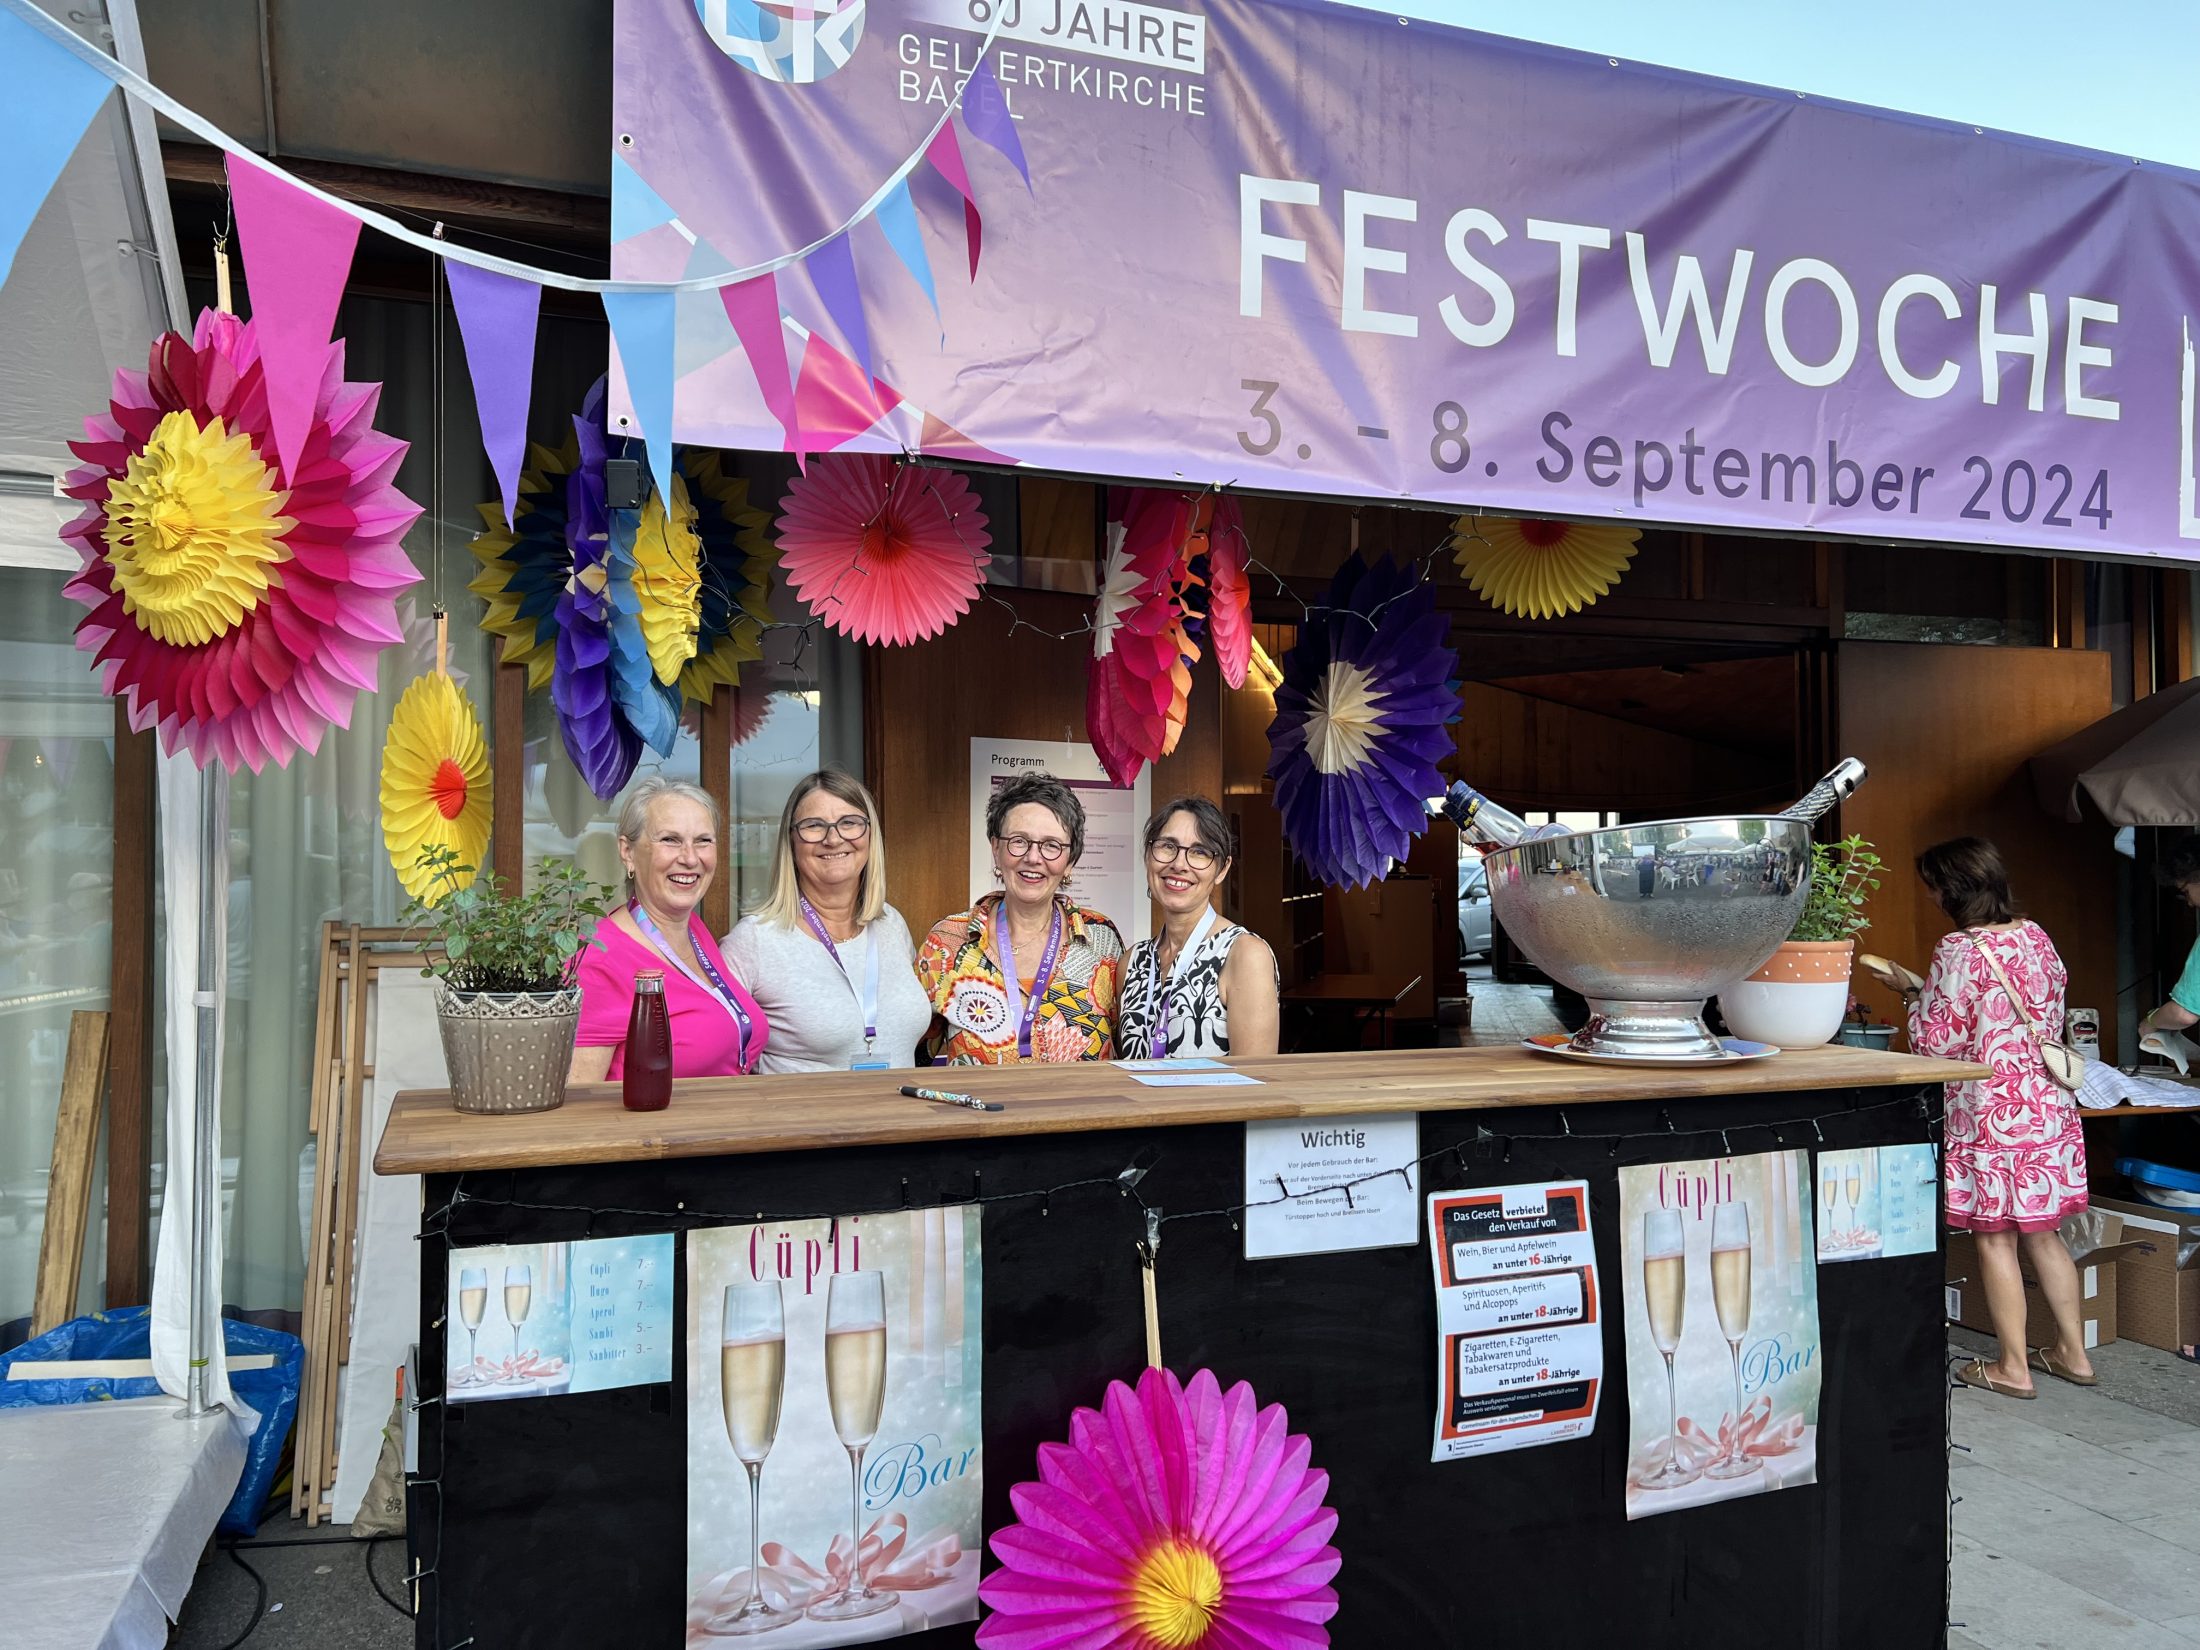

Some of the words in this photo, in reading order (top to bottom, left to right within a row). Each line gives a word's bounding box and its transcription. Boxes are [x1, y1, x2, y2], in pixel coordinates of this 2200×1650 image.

[1040, 0, 1196, 63] JAHRE
[1239, 173, 2120, 421] FESTWOCHE
[1237, 379, 1311, 460] 3.
[1430, 401, 1499, 477] 8.
[1536, 411, 1934, 515] September
[1960, 456, 2113, 530] 2024
[991, 754, 1044, 767] Programm
[1301, 1129, 1365, 1149] Wichtig
[1300, 1161, 1321, 1169] jedem
[1322, 1157, 1352, 1167] Gebrauch
[1659, 1159, 1733, 1220] Cüpli
[1453, 1212, 1469, 1221] Das
[1471, 1209, 1500, 1220] Gesetz
[1506, 1204, 1544, 1216] verbietet
[1489, 1222, 1505, 1232] den
[1507, 1219, 1539, 1231] Verkauf
[1541, 1219, 1557, 1227] von
[749, 1216, 861, 1295] Cüpli
[1457, 1248, 1481, 1257] Wein,
[1482, 1245, 1498, 1255] Bier
[1500, 1243, 1516, 1253] und
[1518, 1240, 1557, 1252] Apfelwein
[1505, 1259, 1527, 1268] unter
[1529, 1253, 1572, 1266] 16-Jährige
[1462, 1287, 1511, 1301] Spirituosen,
[1512, 1282, 1546, 1295] Aperitifs
[1464, 1301, 1480, 1311] und
[1482, 1298, 1518, 1310] Alcopops
[1511, 1312, 1533, 1321] unter
[1535, 1305, 1578, 1318] 18-Jährige
[1464, 1340, 1508, 1353] Zigaretten,
[1510, 1334, 1560, 1347] E-Zigaretten,
[1464, 1351, 1513, 1363] Tabakwaren
[1515, 1347, 1532, 1357] und
[1742, 1331, 1817, 1393] Bar
[1465, 1357, 1549, 1375] Tabakersatzprodukte
[1499, 1378, 1509, 1386] an
[1511, 1375, 1534, 1384] unter
[1536, 1368, 1580, 1381] 18-Jährige
[865, 1433, 977, 1511] Bar
